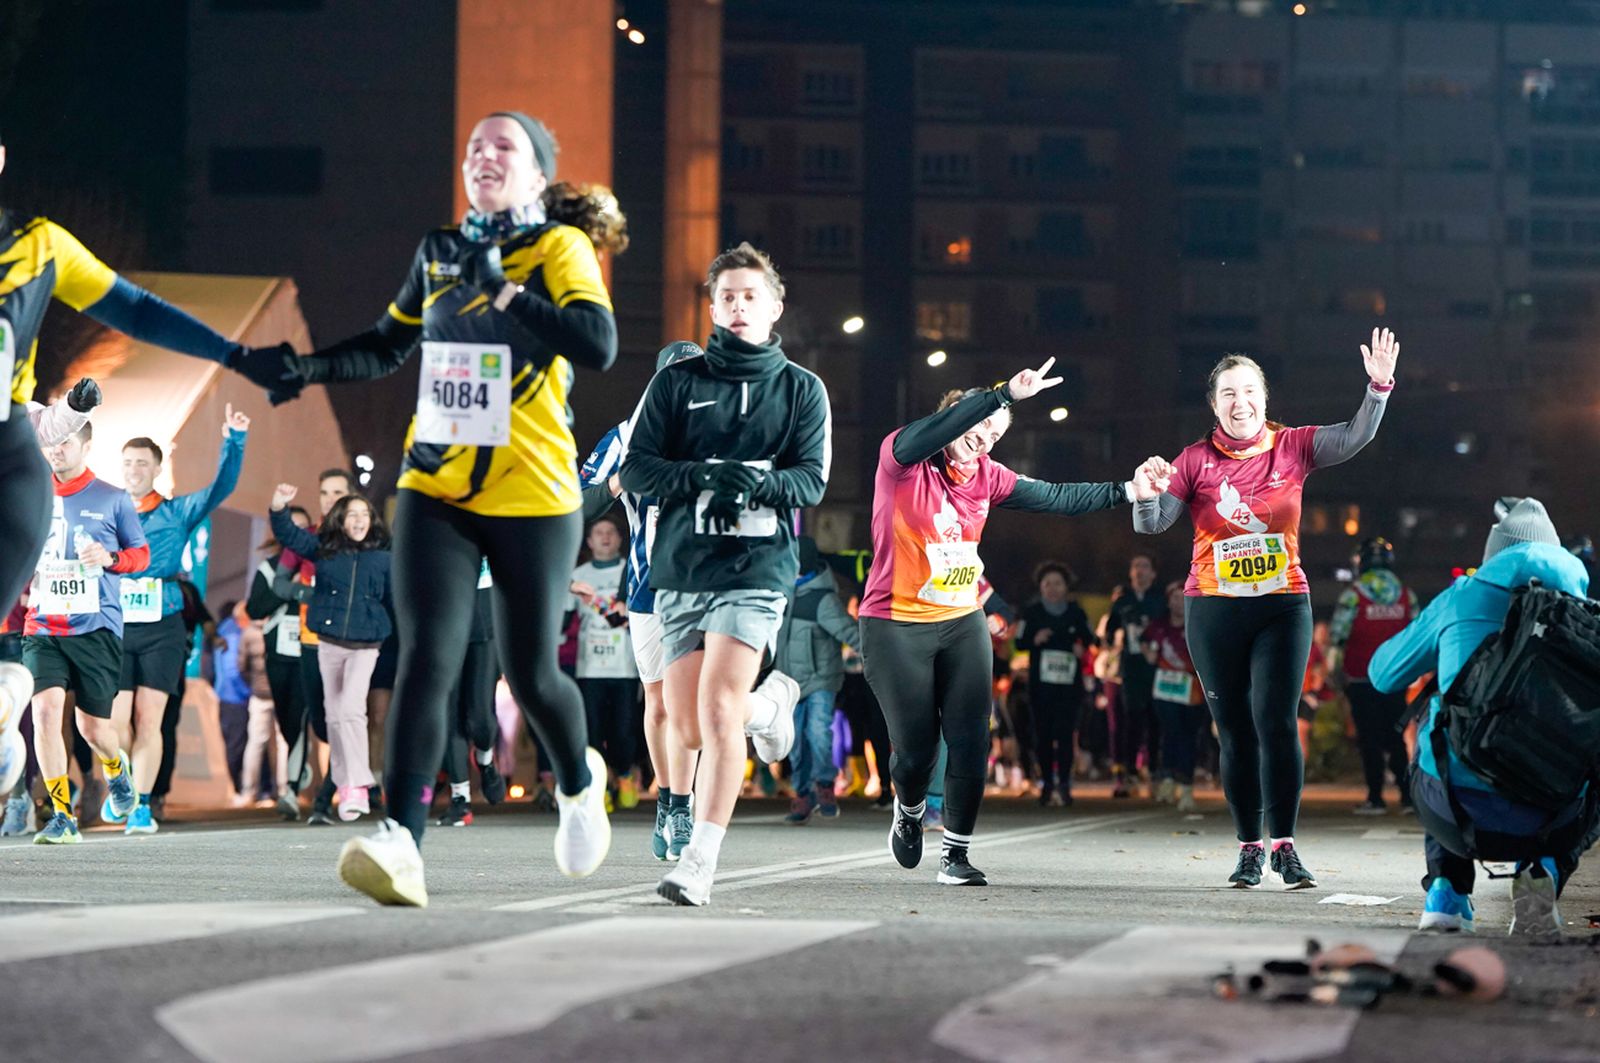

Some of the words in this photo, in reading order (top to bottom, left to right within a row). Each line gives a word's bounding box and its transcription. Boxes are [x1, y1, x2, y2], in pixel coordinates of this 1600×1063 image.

[433, 381, 489, 409] 5084
[1231, 508, 1250, 525] 43
[1231, 541, 1251, 551] NOCHE
[1252, 539, 1261, 547] DE
[1223, 552, 1237, 560] SAN
[1229, 555, 1277, 578] 2094
[50, 580, 86, 596] 4691
[124, 593, 149, 606] 741
